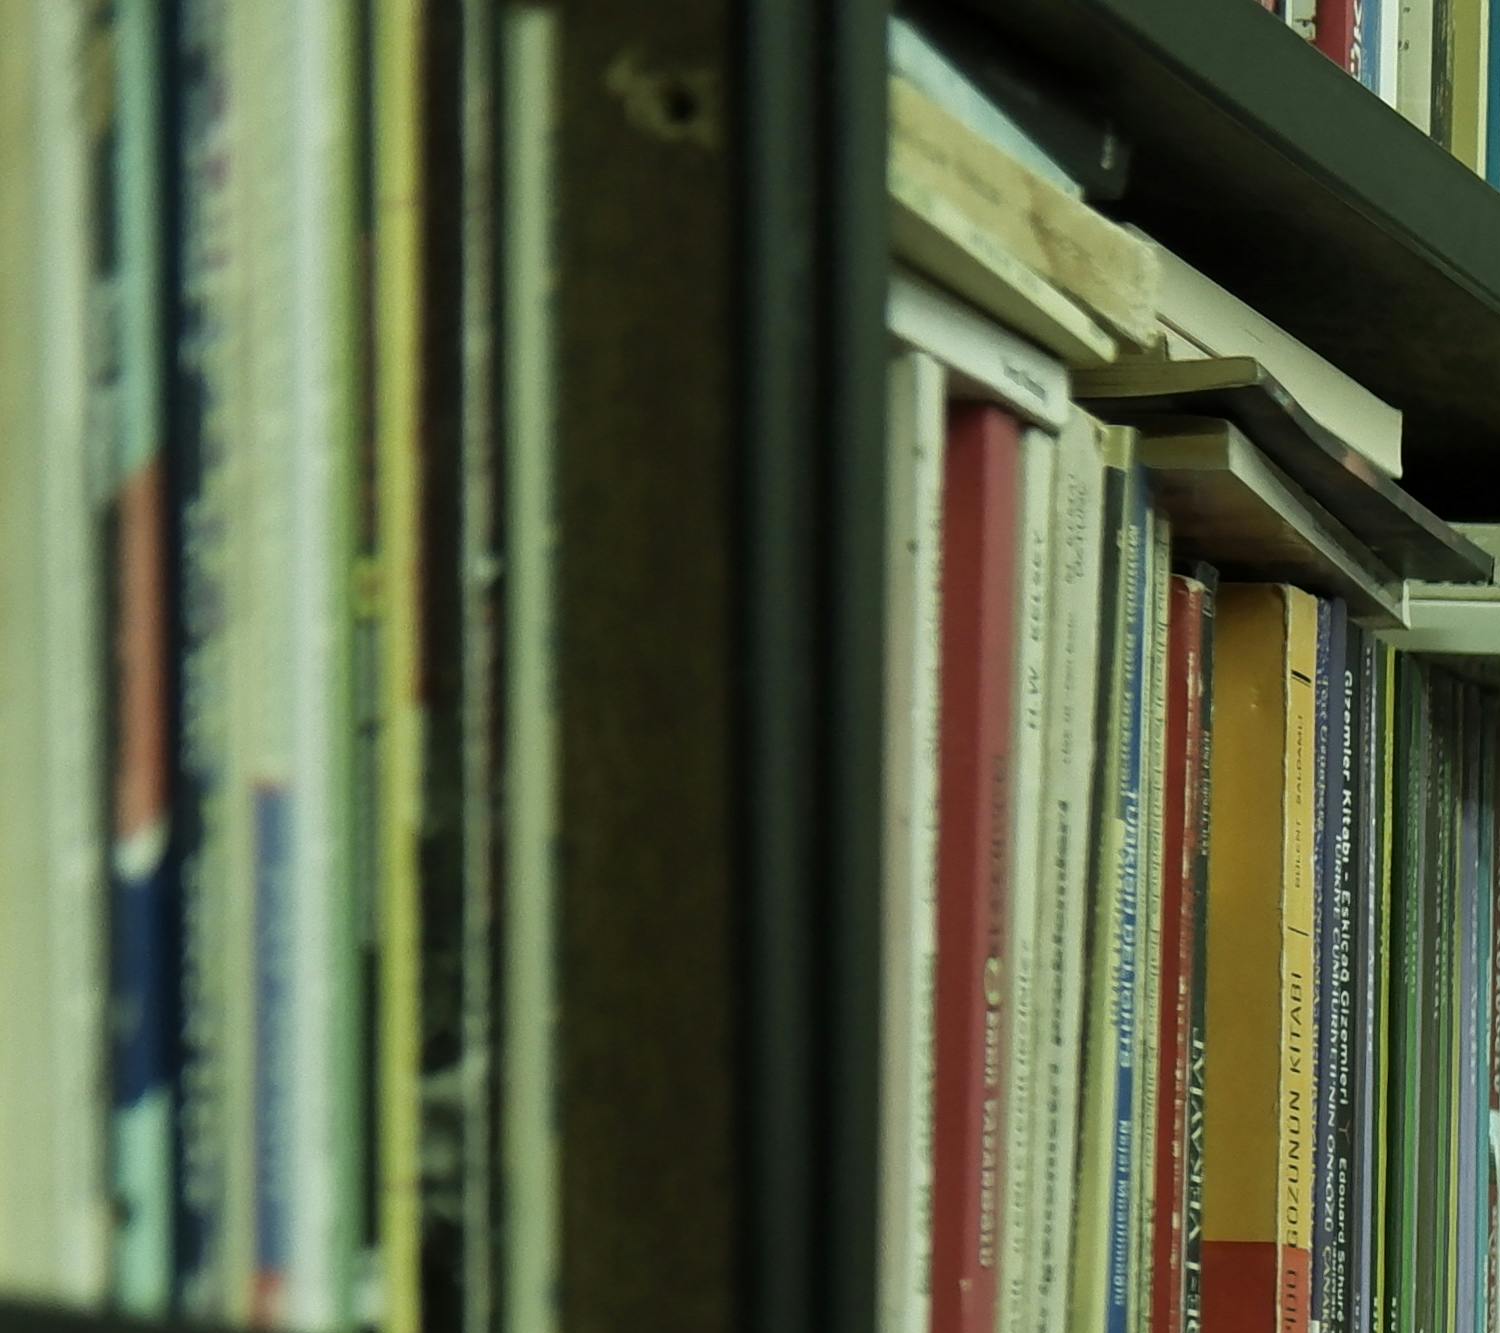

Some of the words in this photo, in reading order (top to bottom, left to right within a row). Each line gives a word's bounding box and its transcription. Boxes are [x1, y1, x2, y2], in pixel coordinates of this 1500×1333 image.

[1342, 670, 1354, 781] Gizemler
[1341, 789, 1353, 865] Kitabı
[1338, 890, 1351, 982] Eskiçağ
[1338, 989, 1350, 1105] Gizemleri
[1337, 1157, 1347, 1243] Edouard
